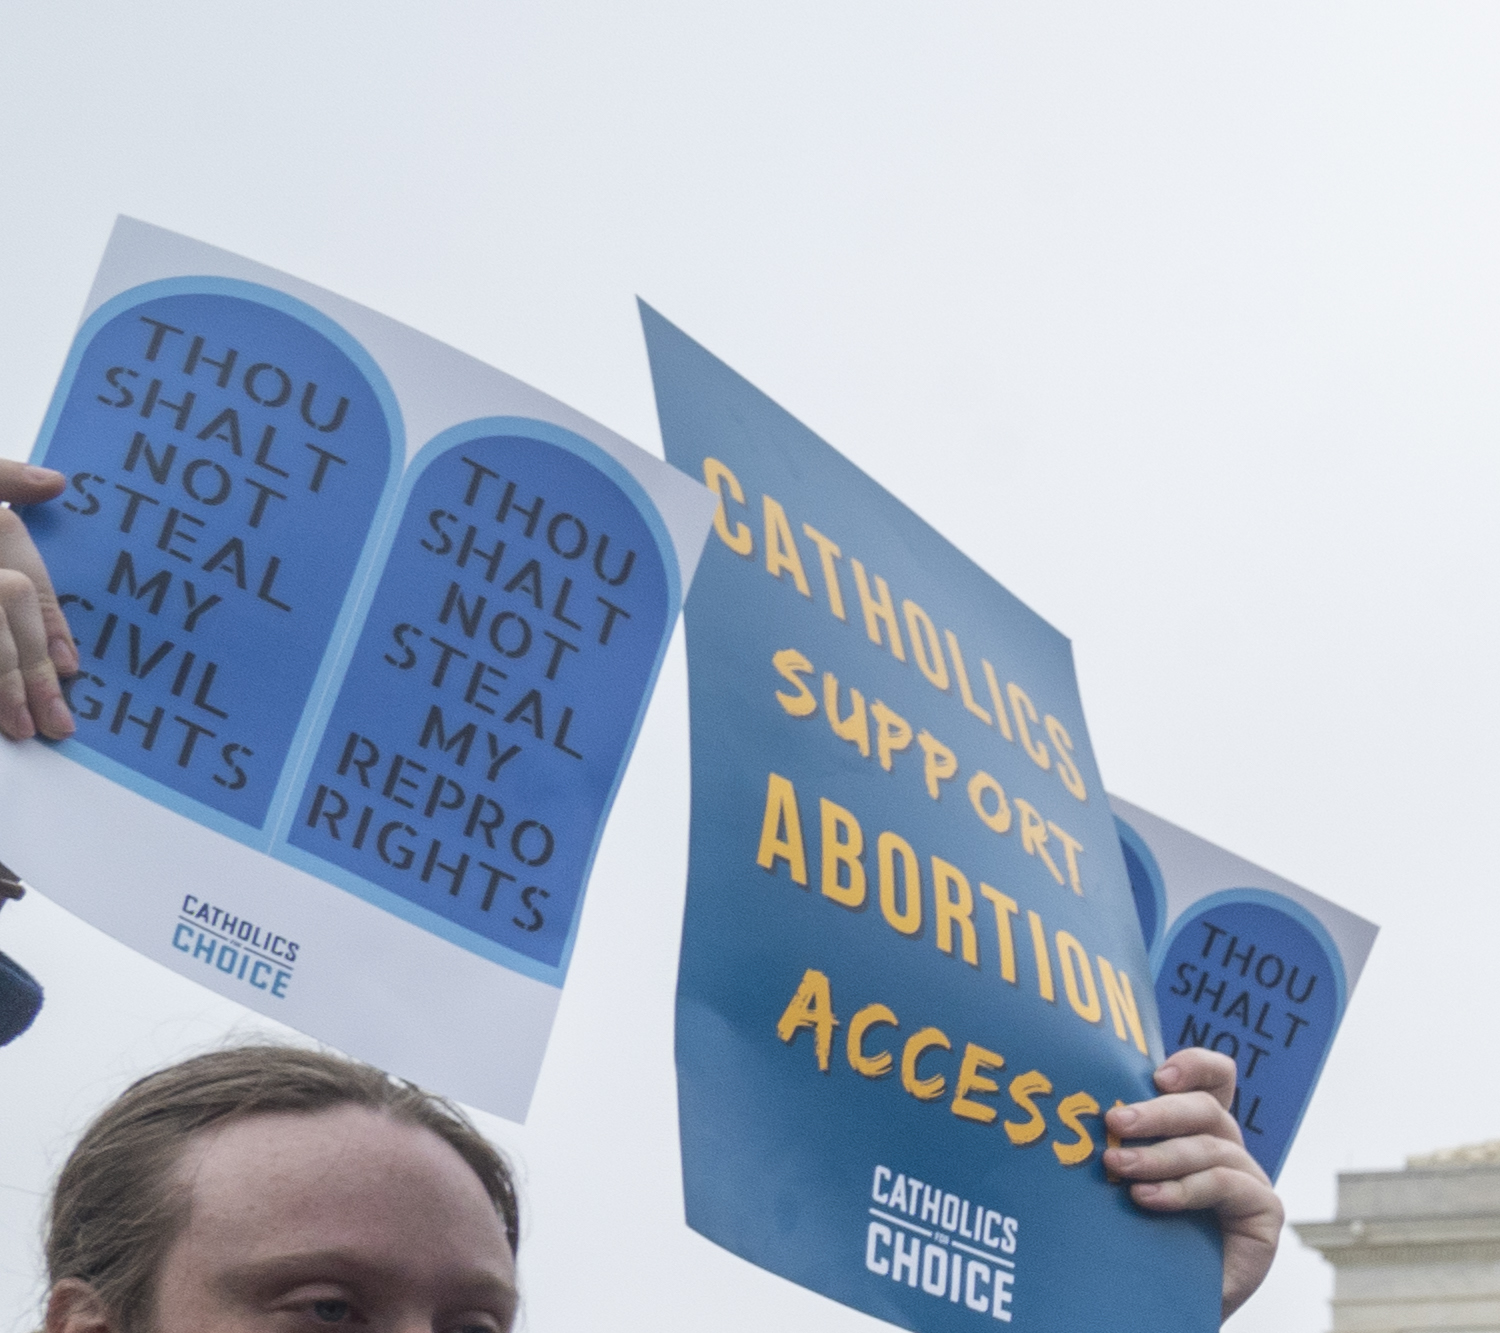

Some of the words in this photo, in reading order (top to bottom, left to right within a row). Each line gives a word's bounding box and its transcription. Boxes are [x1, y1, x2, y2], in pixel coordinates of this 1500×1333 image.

[97, 366, 348, 493] SHALT
[139, 316, 351, 434] THOU
[122, 431, 287, 529] NOT
[461, 456, 637, 587] THOU
[62, 471, 292, 612] STEAL
[106, 549, 223, 633] MY
[420, 508, 631, 647] SHALT
[438, 581, 580, 681] NOT
[703, 457, 1087, 801] CATHOLICS
[62, 670, 254, 791] GHTS
[384, 622, 583, 761] STEAL
[418, 704, 522, 782] MY
[336, 732, 555, 867] REPRO
[772, 648, 1084, 896] SUPPORT
[306, 784, 550, 933] RIGHTS
[172, 922, 292, 999] CHOICE
[182, 894, 299, 962] CATHOLICS
[757, 772, 1148, 1056] ABORTION
[1203, 922, 1318, 1004] THOU
[1170, 962, 1309, 1048] SHALT
[1177, 1014, 1270, 1078] NOT
[872, 1165, 1018, 1254] CATHOLICS
[934, 1232, 950, 1245] FOR
[866, 1221, 1015, 1323] CHOICE
